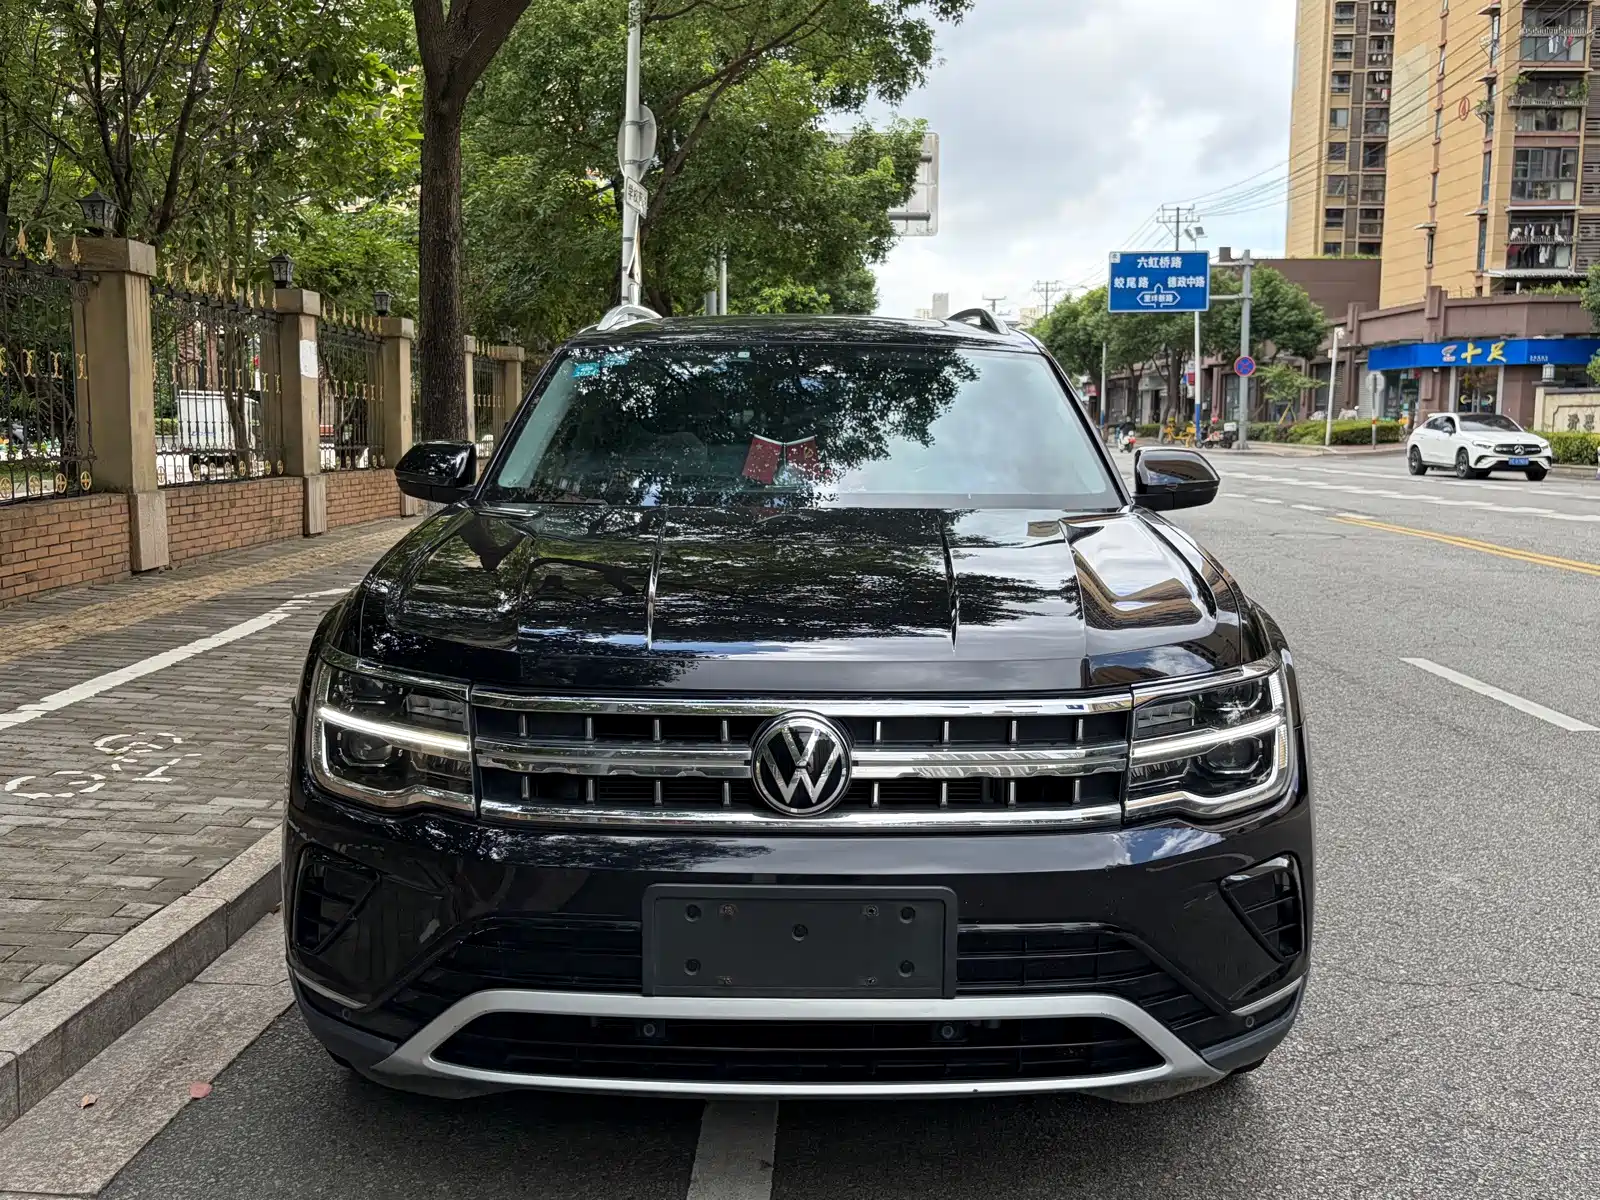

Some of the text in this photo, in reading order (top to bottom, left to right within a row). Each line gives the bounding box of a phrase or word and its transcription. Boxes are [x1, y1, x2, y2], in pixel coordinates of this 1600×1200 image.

[1137, 256, 1182, 269] 六虹桥路
[1167, 275, 1205, 288] 德政中路
[1461, 341, 1507, 364] 十足
